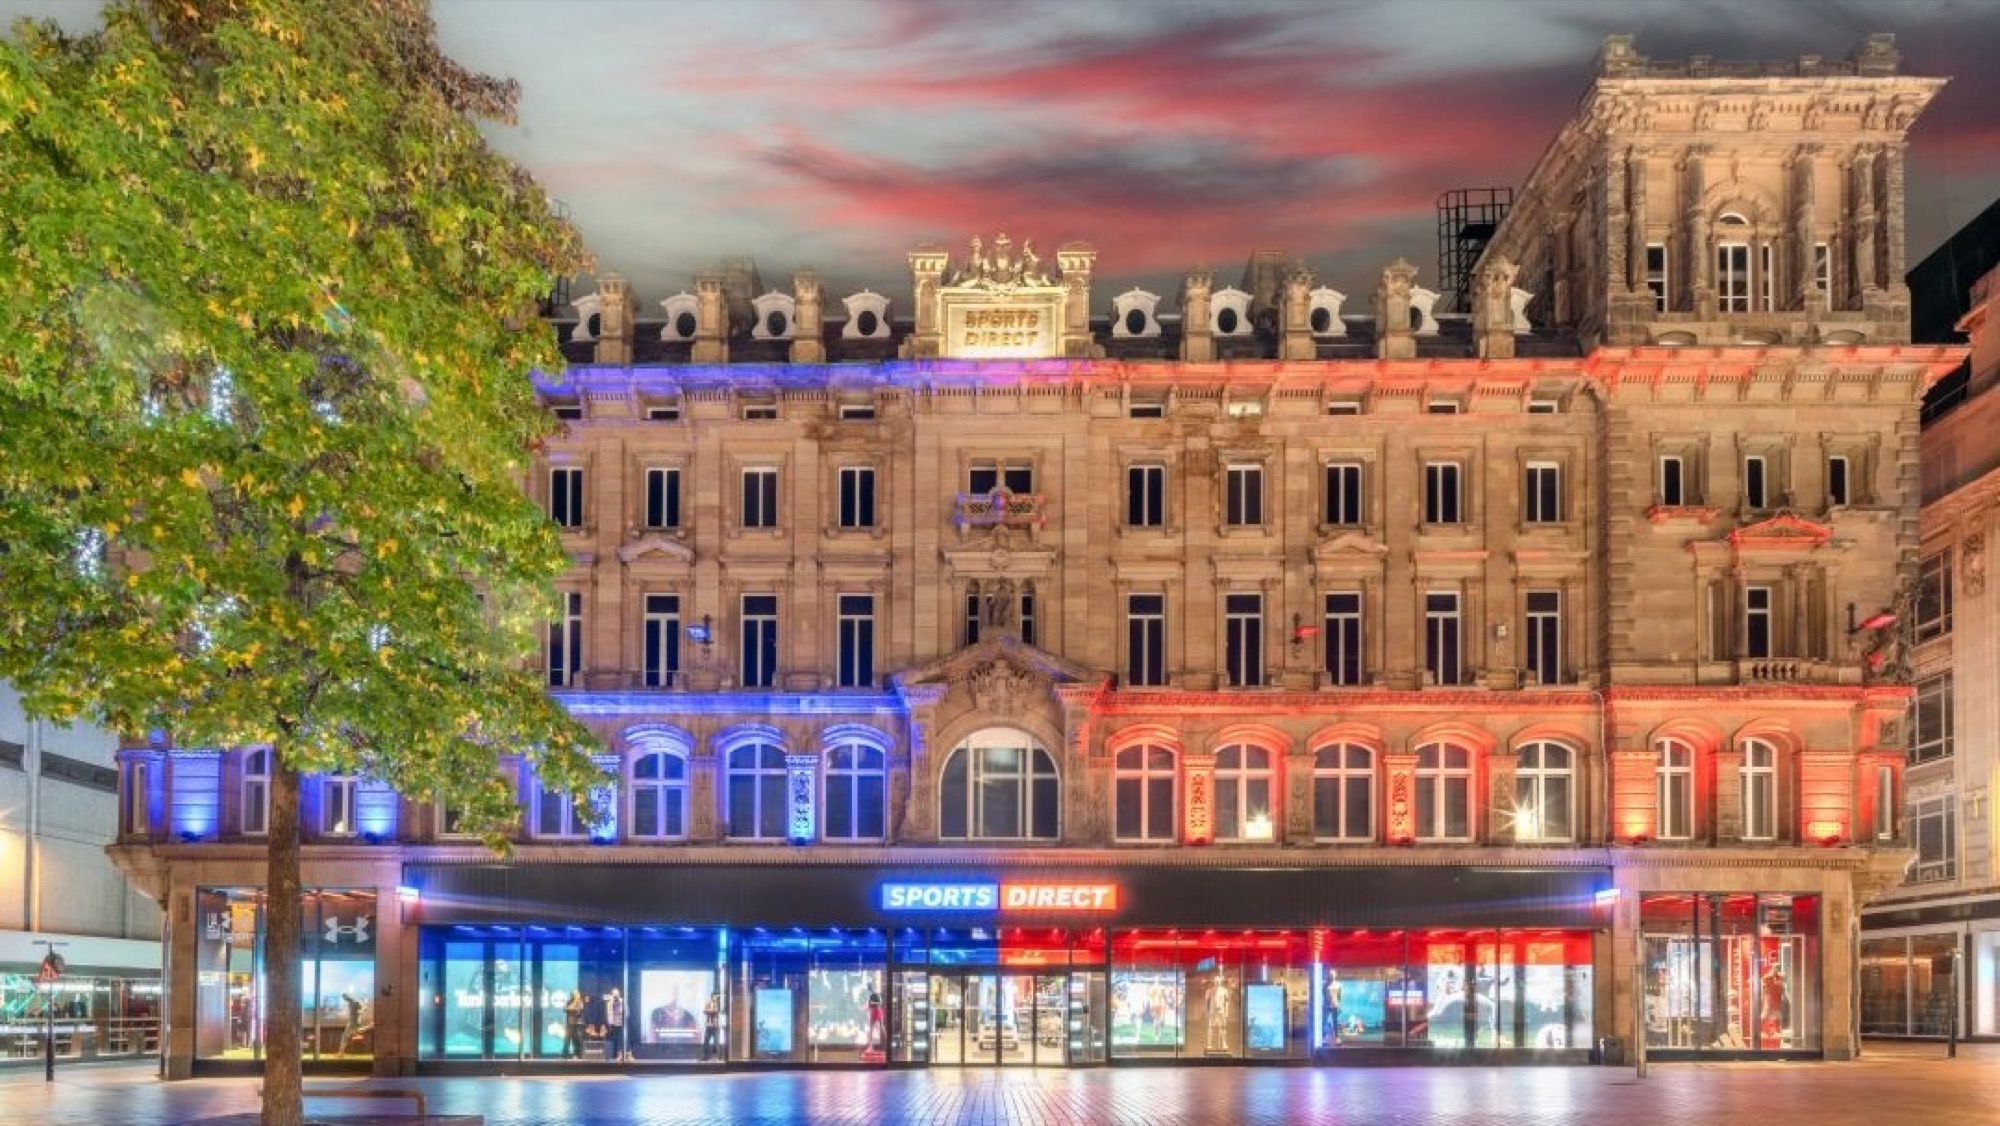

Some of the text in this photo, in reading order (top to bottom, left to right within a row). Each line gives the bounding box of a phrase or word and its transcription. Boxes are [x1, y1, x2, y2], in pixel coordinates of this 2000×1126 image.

[965, 309, 1038, 328] SPORTS
[965, 331, 1038, 346] DIRECT
[889, 886, 1108, 906] SPORTS DIRECT
